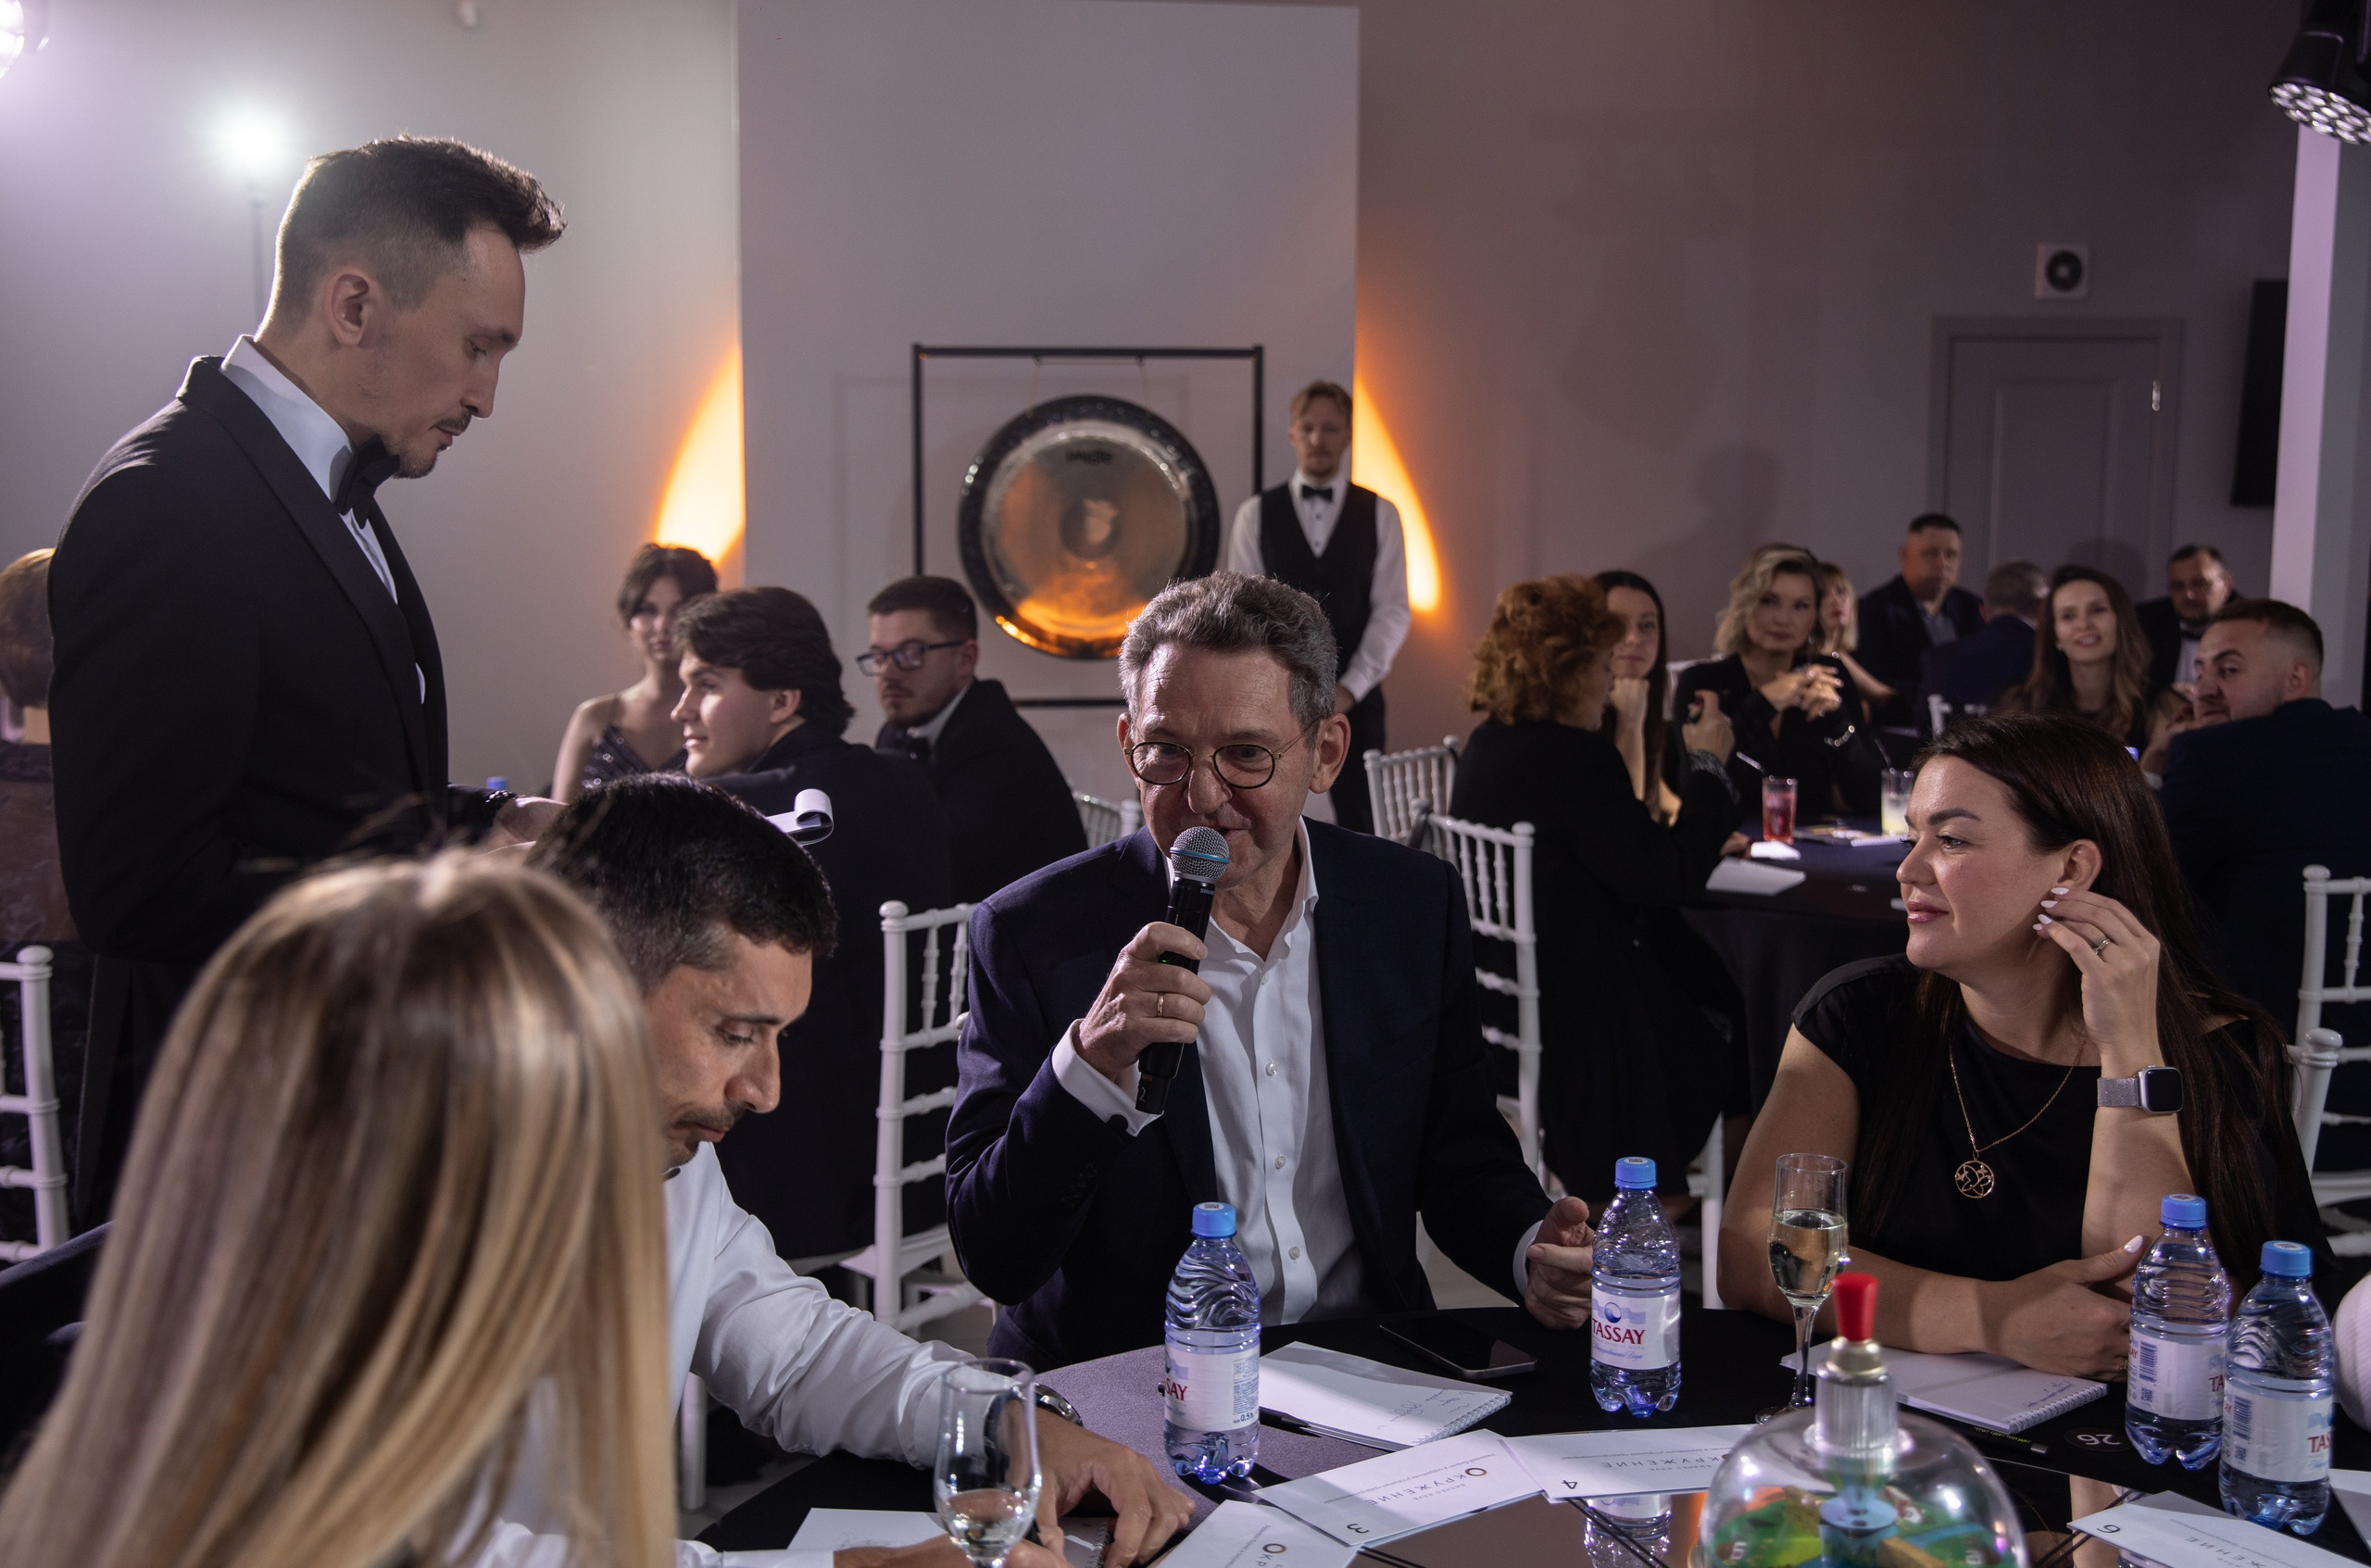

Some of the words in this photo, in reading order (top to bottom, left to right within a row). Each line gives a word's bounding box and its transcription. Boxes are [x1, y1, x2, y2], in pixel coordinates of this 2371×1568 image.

[1139, 1086, 1147, 1102] 2
[1591, 1318, 1646, 1345] TASSAY
[2076, 1434, 2121, 1445] 26
[1600, 1454, 1730, 1469] КРУЖЕНИЕ
[1365, 1467, 1487, 1506] ОКРУЖЕНИЕ
[1562, 1480, 1577, 1489] 4
[1347, 1523, 1370, 1534] 3
[2097, 1524, 2121, 1534] 6
